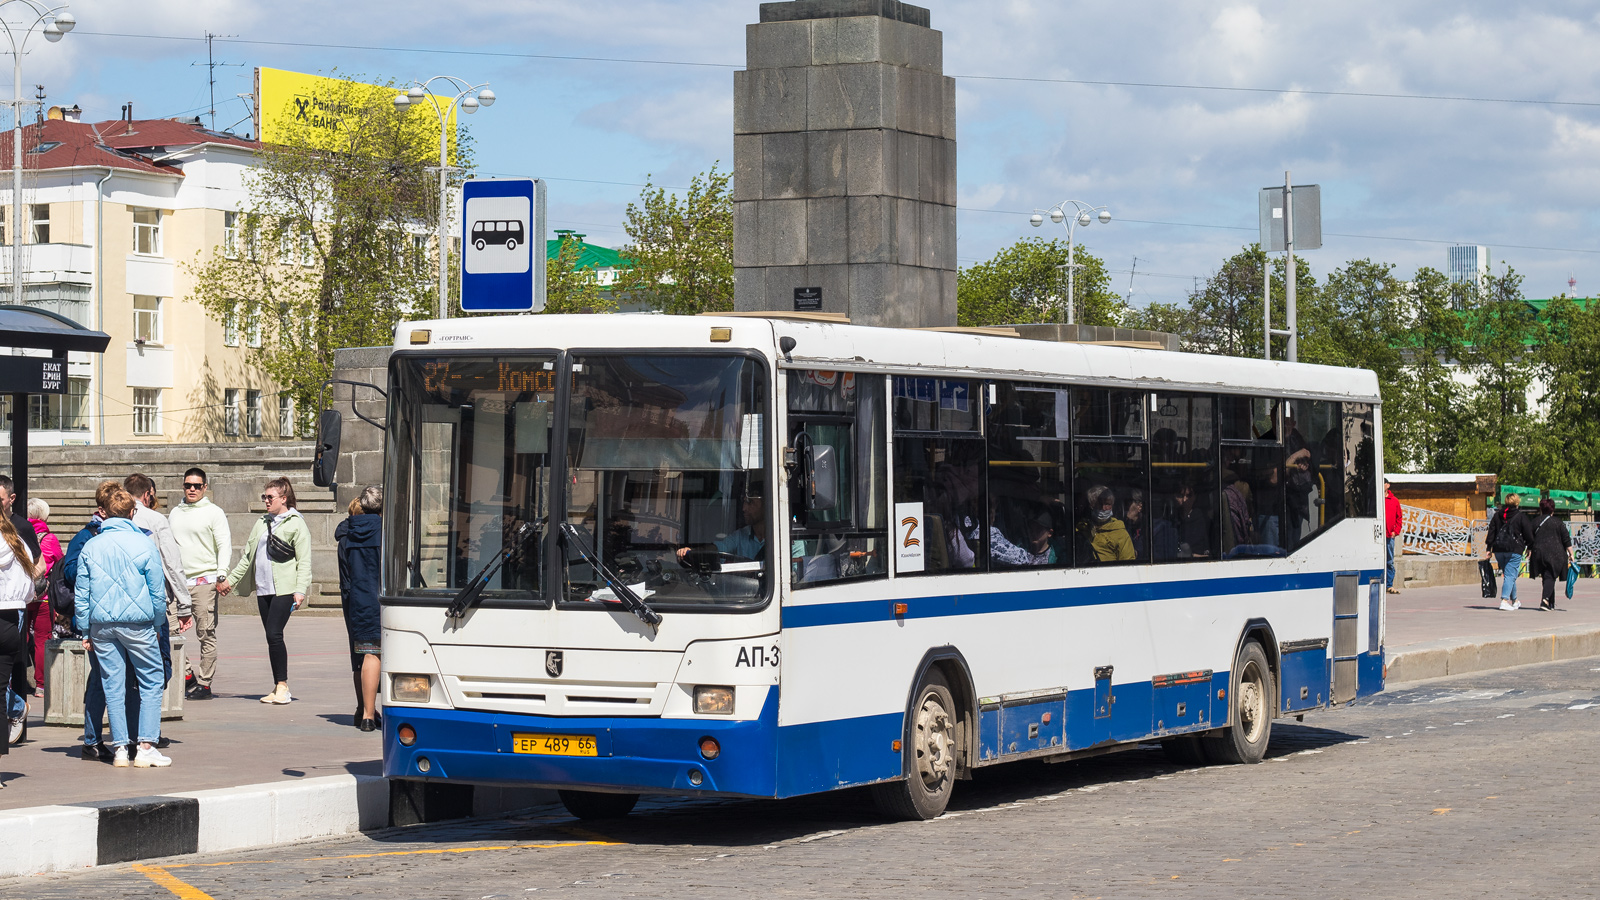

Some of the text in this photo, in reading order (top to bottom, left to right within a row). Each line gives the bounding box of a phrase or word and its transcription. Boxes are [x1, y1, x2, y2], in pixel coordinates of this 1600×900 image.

[313, 115, 338, 130] БАНК
[42, 362, 62, 371] ЕКАТ
[42, 372, 62, 381] ЕРИН
[42, 381, 62, 390] БУРГ
[1402, 522, 1438, 540] RIN
[1403, 534, 1438, 552] URG
[735, 645, 779, 667] АП-3
[521, 737, 592, 752] ЕР 489 66
